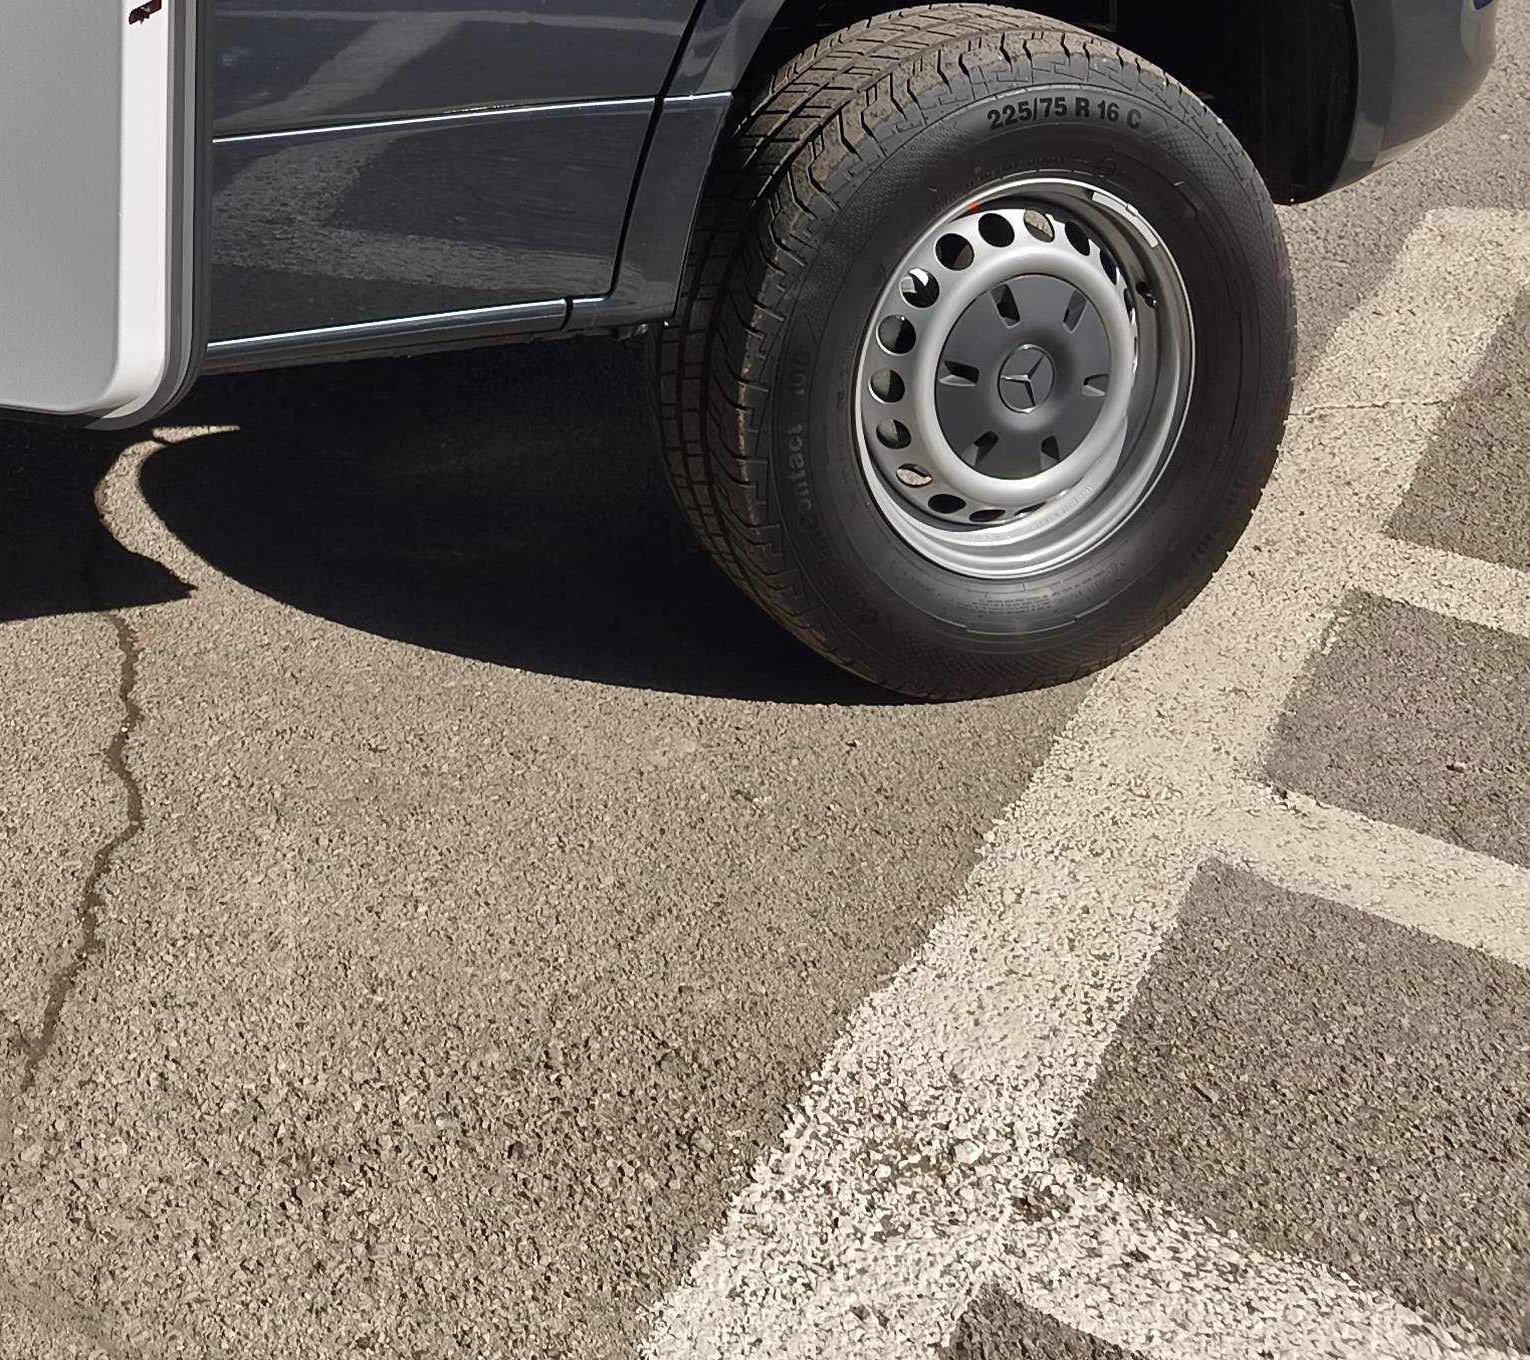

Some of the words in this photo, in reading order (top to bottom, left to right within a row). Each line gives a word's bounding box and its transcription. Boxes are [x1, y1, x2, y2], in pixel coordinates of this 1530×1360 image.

[986, 96, 1069, 131] 225/75
[1074, 96, 1091, 119] R
[1097, 99, 1121, 123] 16
[1126, 108, 1143, 130] C
